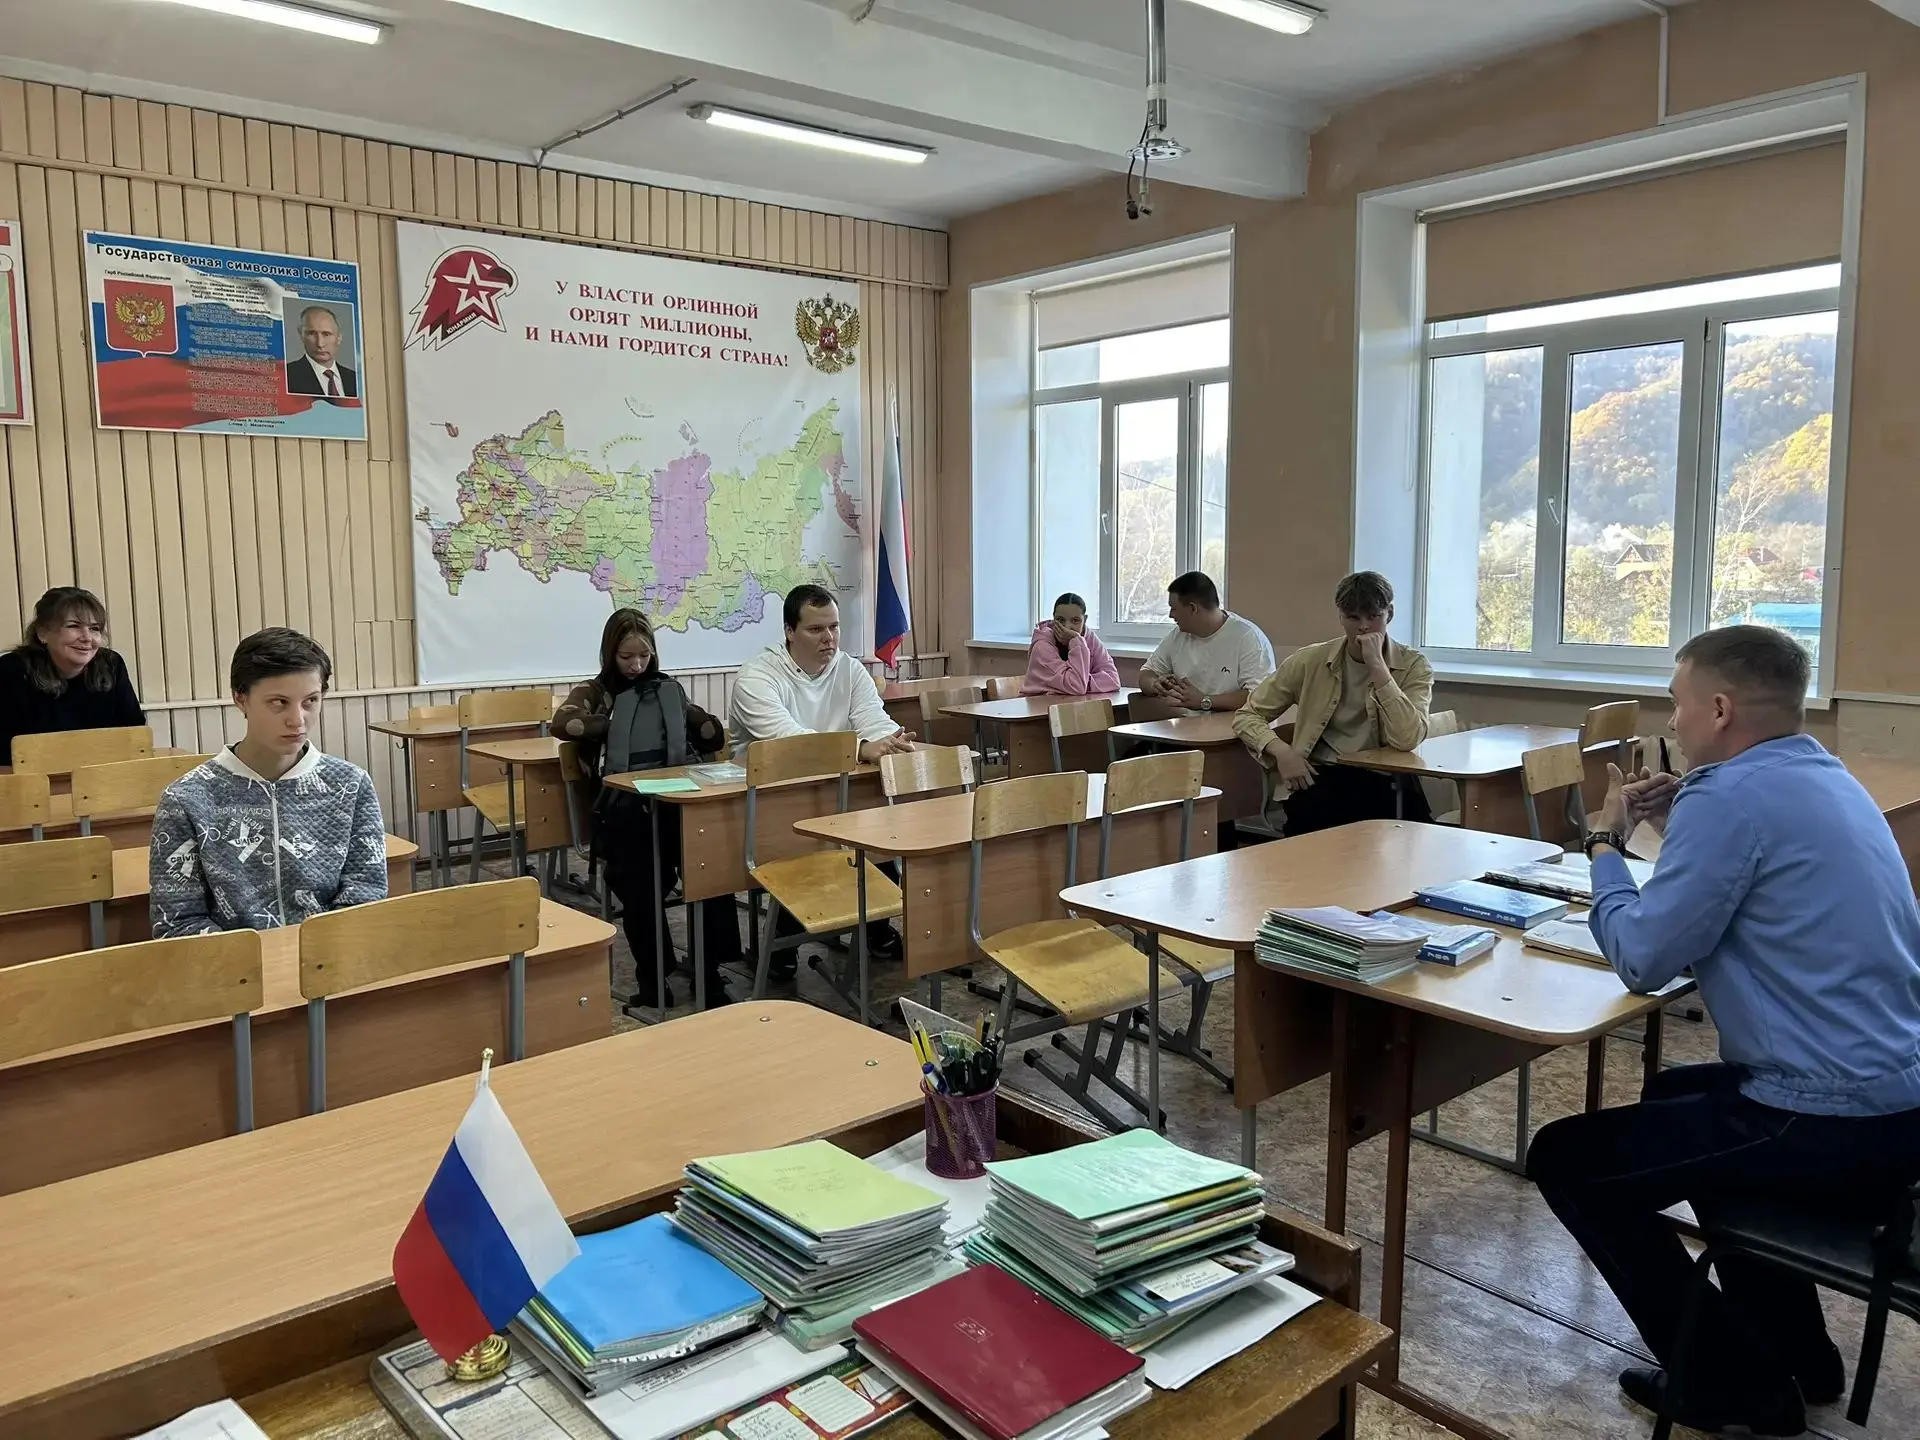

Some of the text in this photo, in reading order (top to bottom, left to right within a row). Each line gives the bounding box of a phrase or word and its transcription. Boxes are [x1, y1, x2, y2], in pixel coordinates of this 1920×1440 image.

[96, 243, 222, 268] Государственная
[227, 260, 299, 277] символика
[304, 267, 351, 284] России
[555, 280, 759, 320] У ВЛАСТИ ОРЛИННОЙ
[446, 312, 477, 335] ЮНАРМИЯ
[569, 306, 753, 343] ОРЛЯТ МИЛЛИОНЫ,
[525, 326, 788, 367] И НАМИ ГОРДИТСЯ СТРАНА!
